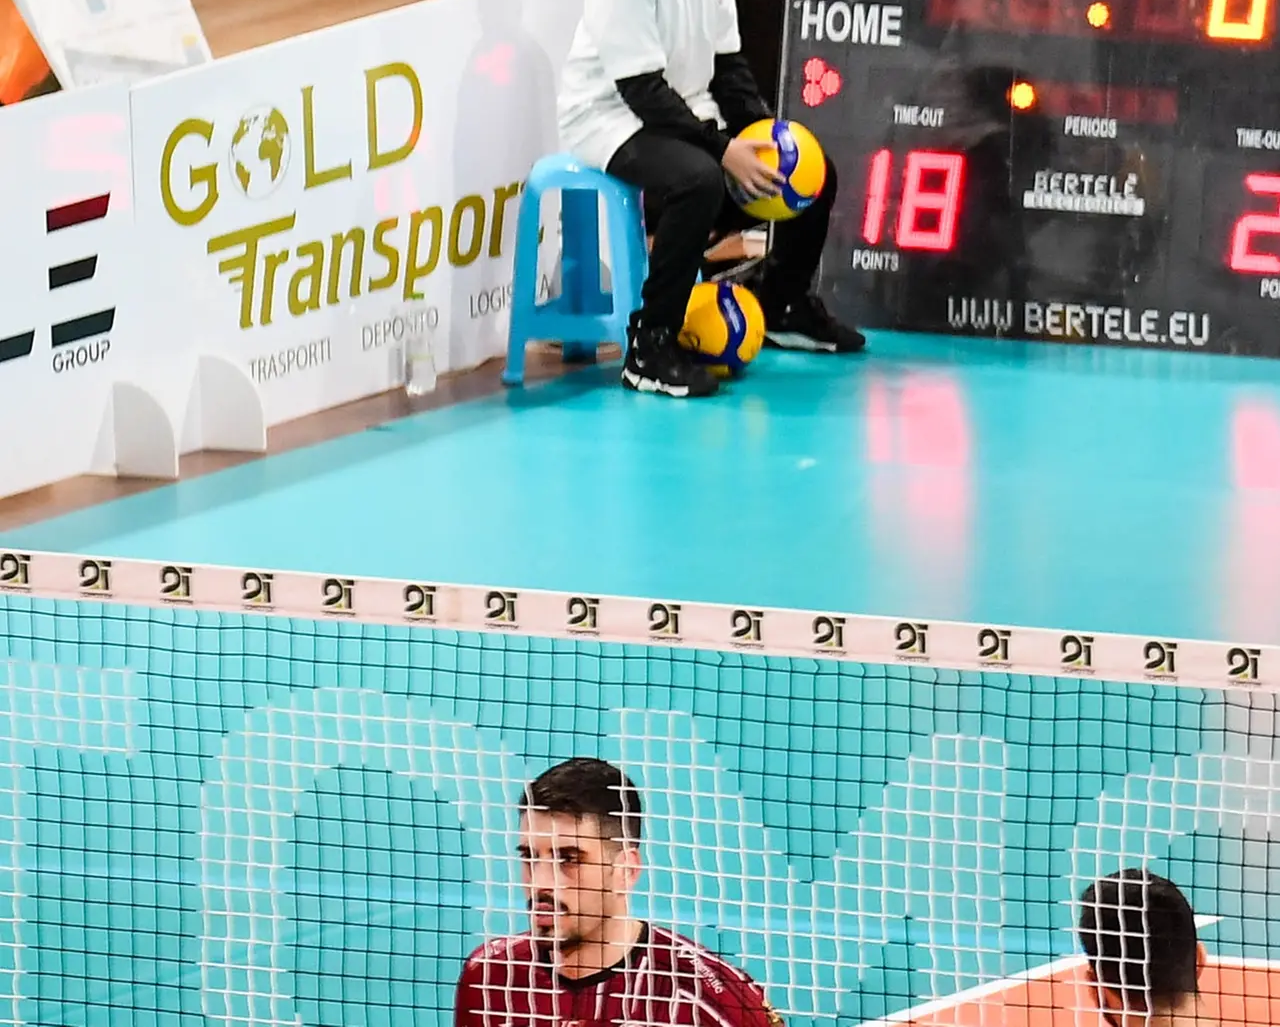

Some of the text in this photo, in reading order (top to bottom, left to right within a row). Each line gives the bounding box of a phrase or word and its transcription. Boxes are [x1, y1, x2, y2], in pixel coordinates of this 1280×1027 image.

[801, 3, 903, 46] HOME
[893, 105, 944, 127] TIME-OUT
[1064, 117, 1117, 138] PERIODS
[160, 61, 423, 226] GOLD
[861, 148, 966, 252] 18
[207, 179, 545, 330] Transpor
[852, 249, 899, 272] POINTS
[361, 306, 439, 352] DEPOSITO
[52, 340, 111, 374] GROUP
[249, 337, 333, 383] TRASPORTI
